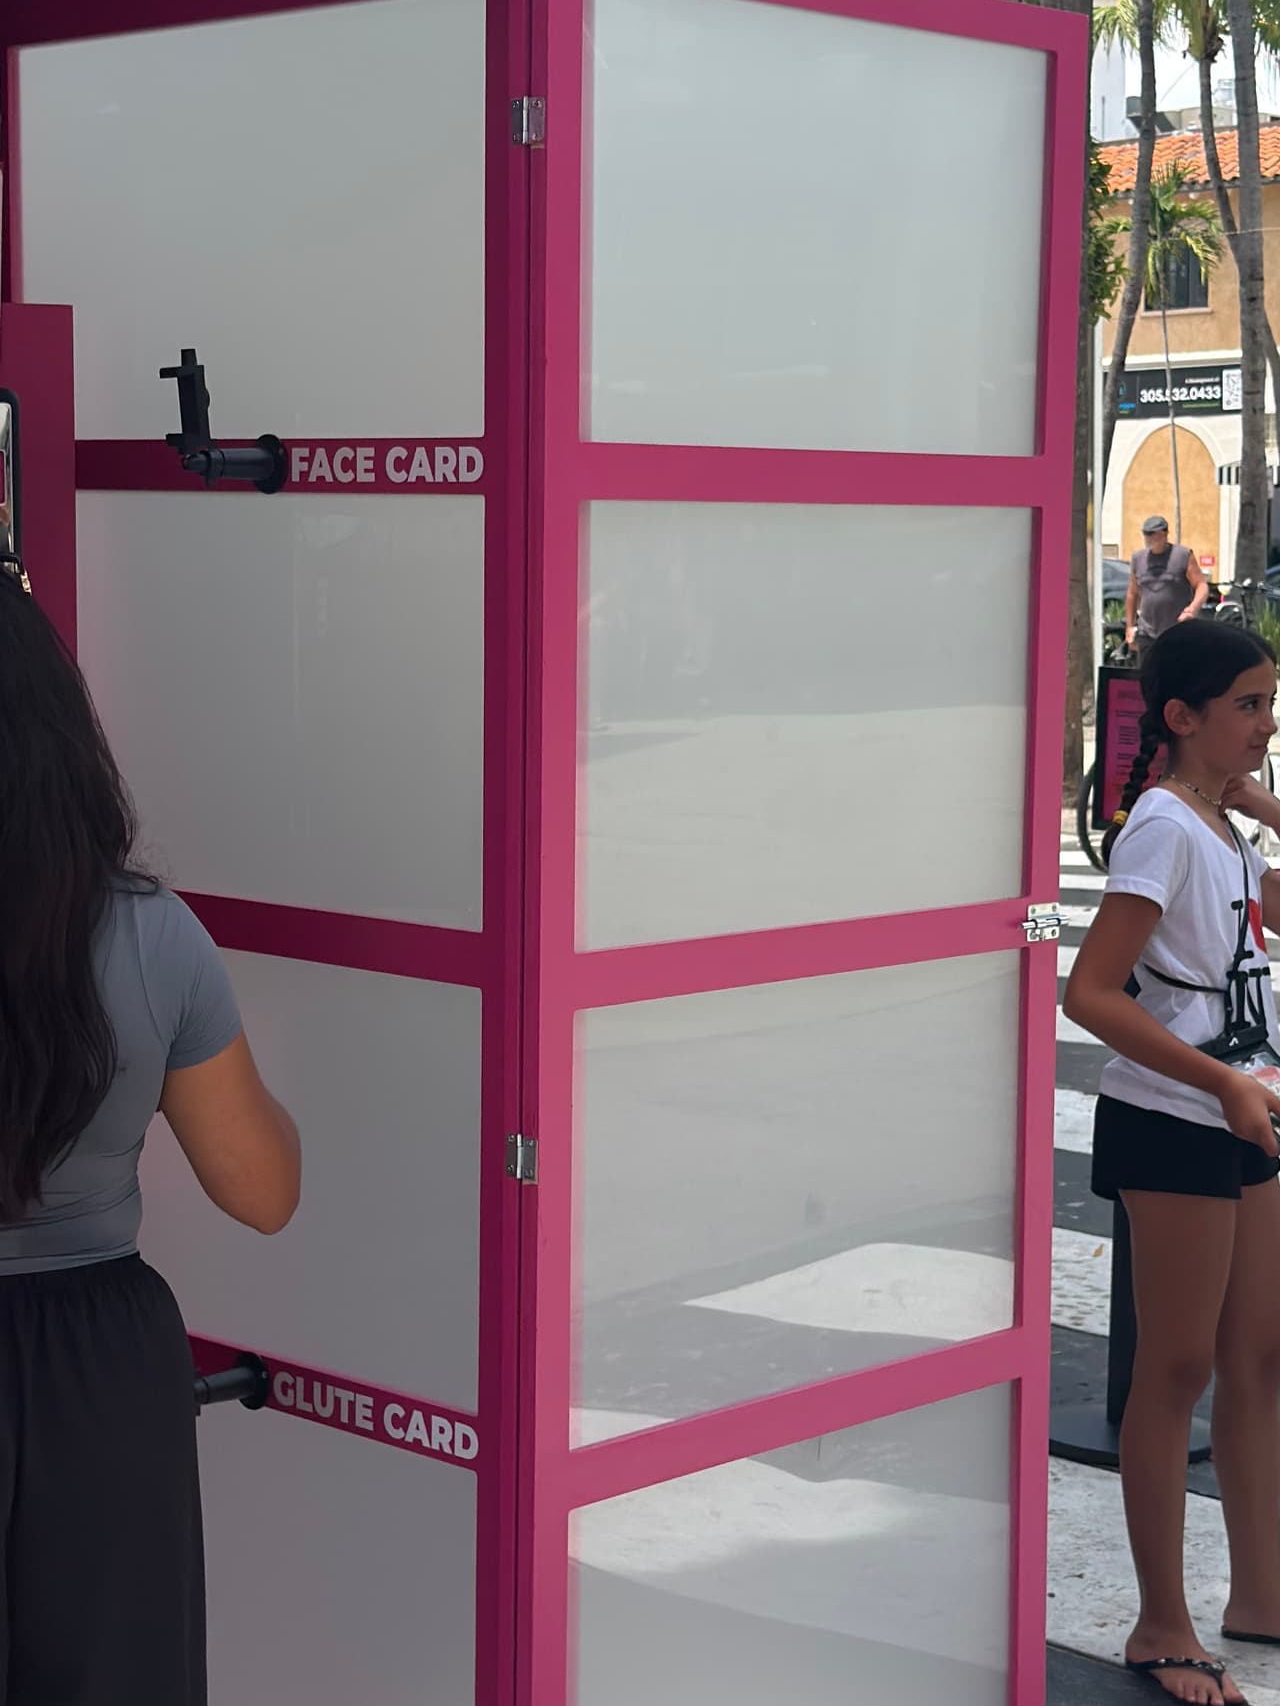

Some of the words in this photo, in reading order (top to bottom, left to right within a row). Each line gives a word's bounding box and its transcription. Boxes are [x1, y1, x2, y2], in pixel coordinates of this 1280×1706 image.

[291, 447, 375, 483] FACE
[385, 446, 484, 483] CARD
[273, 1371, 374, 1431] GLUTE
[383, 1402, 480, 1460] CARD
